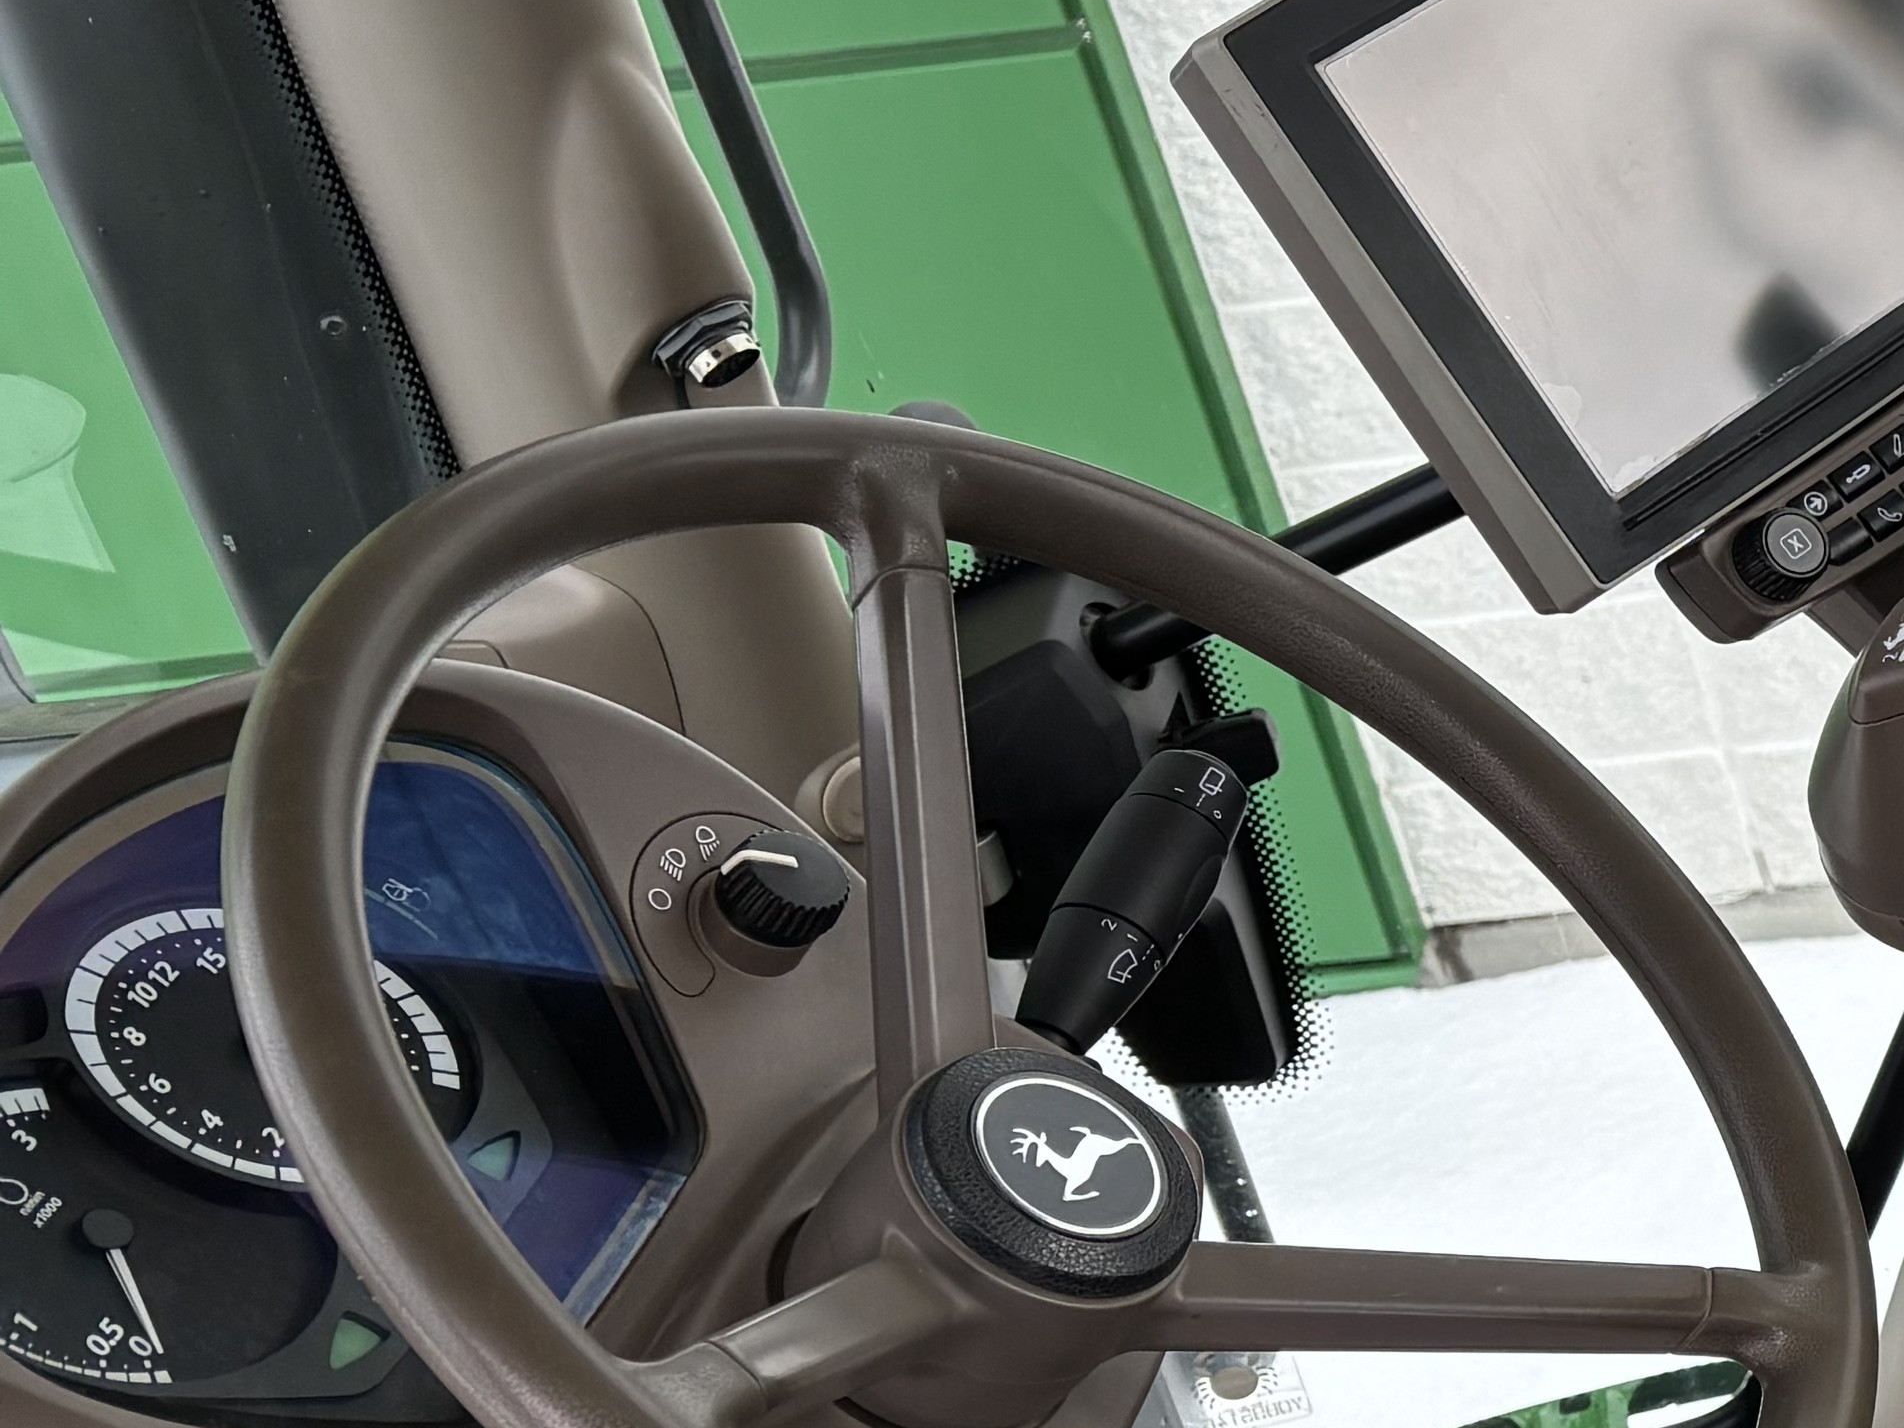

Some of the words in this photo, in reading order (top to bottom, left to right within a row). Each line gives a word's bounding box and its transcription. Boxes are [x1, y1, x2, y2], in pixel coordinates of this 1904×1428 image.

[1101, 918, 1118, 931] 2
[196, 947, 226, 974] 15
[148, 961, 180, 987] 12
[127, 981, 158, 1008] 10
[123, 1026, 147, 1047] 8
[149, 1073, 172, 1094] 6
[201, 1109, 224, 1129] 4
[11, 1129, 38, 1152] 3
[261, 1126, 285, 1148] 2
[33, 1197, 63, 1228] x1000
[13, 1312, 38, 1332] 1
[86, 1316, 125, 1356] 0.5
[128, 1334, 153, 1358] 0
